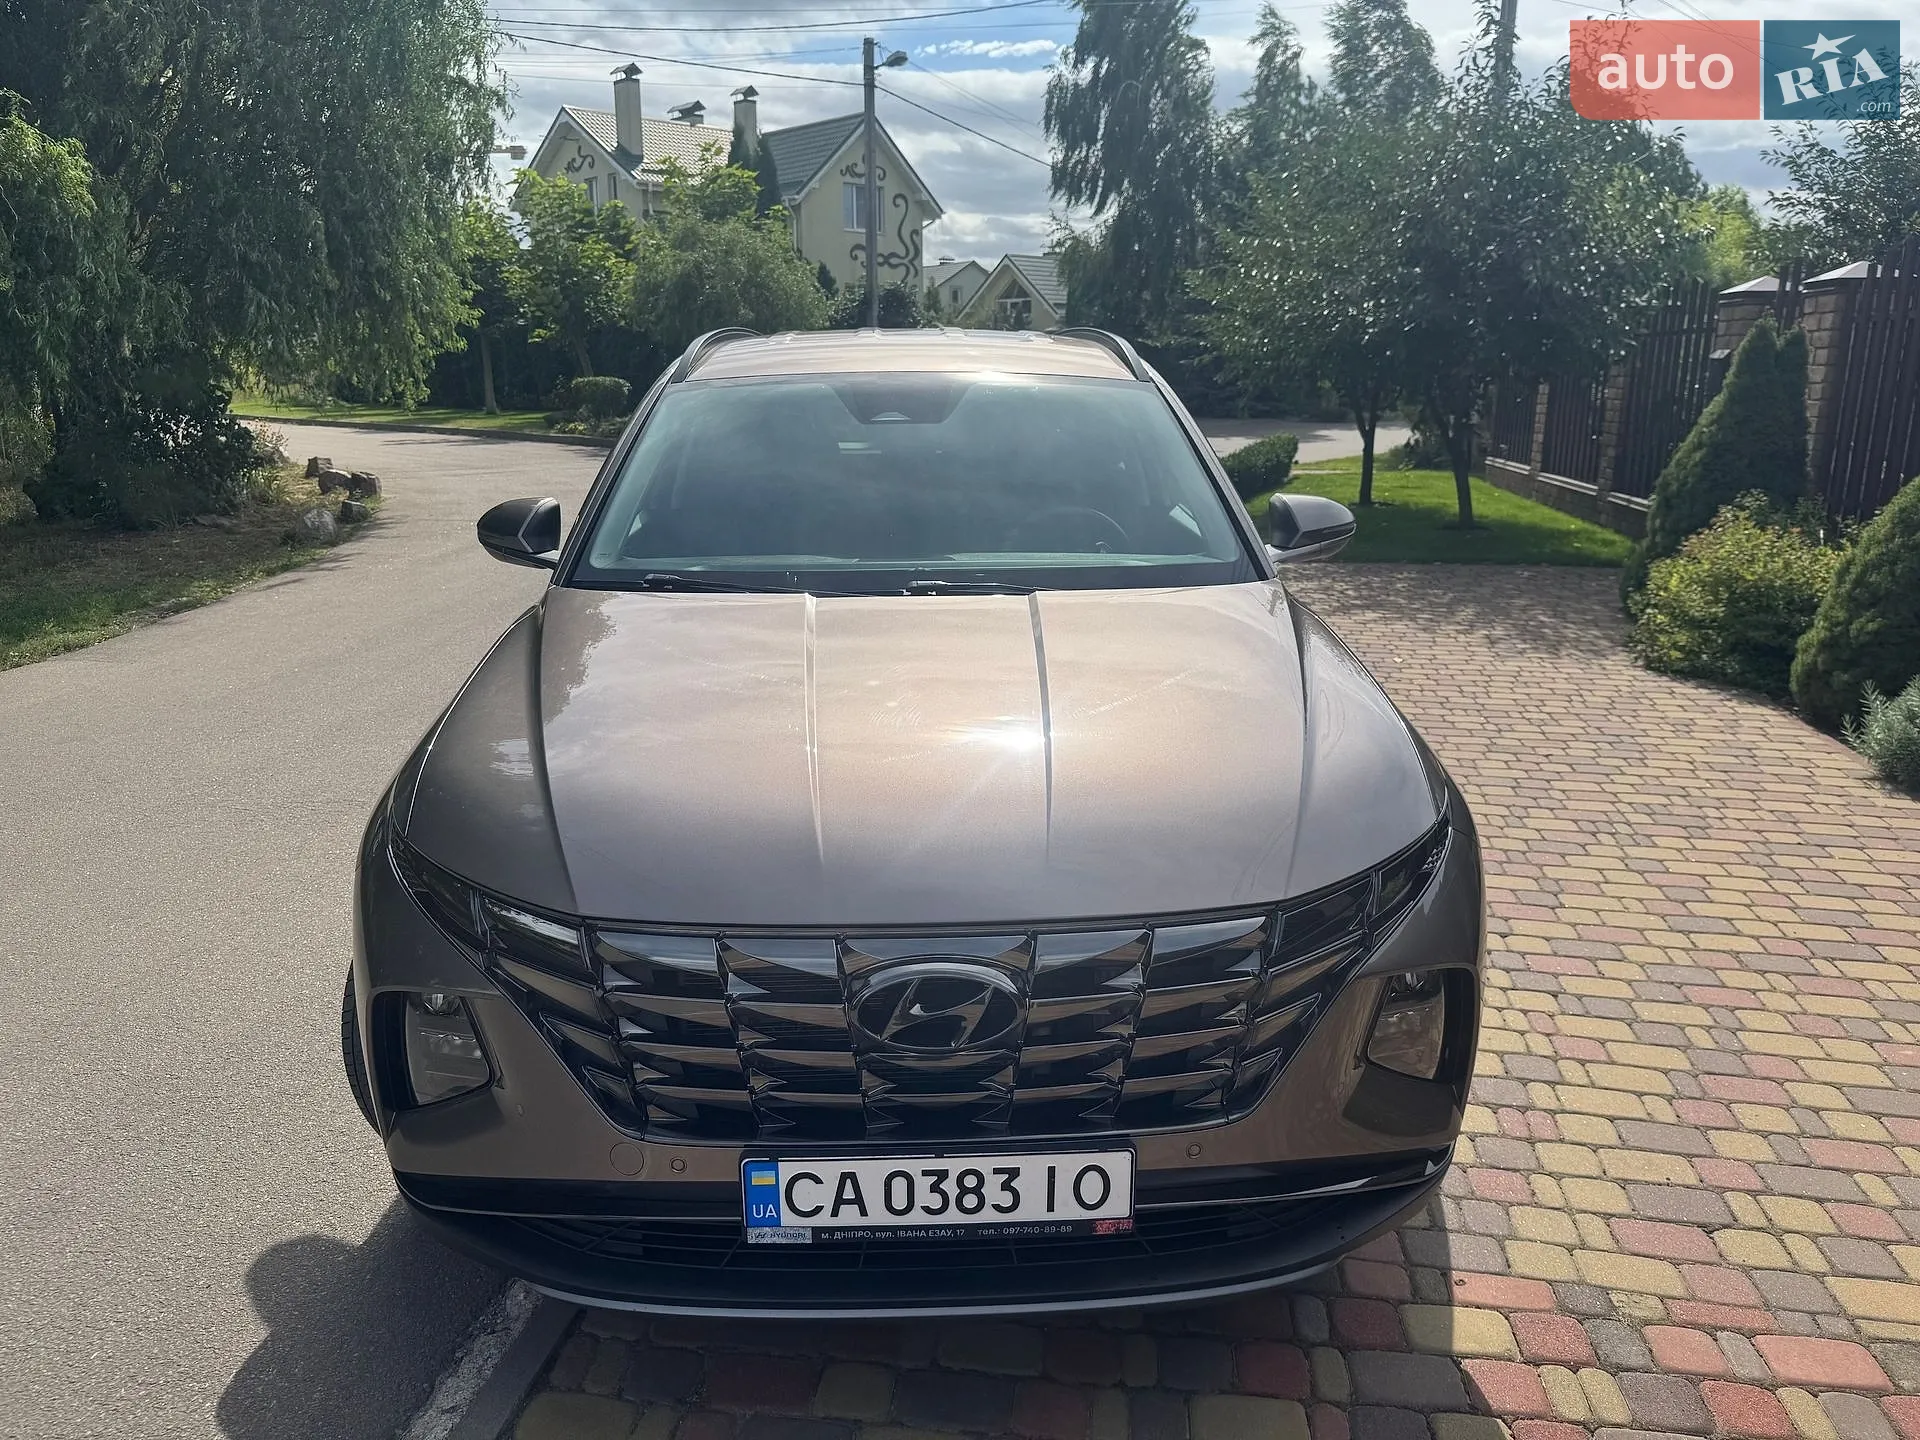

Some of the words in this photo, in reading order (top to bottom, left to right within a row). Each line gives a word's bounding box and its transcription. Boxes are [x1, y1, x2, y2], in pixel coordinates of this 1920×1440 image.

[784, 1171, 869, 1218] CA
[884, 1167, 1021, 1216] 0383
[1046, 1164, 1111, 1213] IO
[752, 1204, 778, 1218] UA
[956, 1229, 965, 1237] 17
